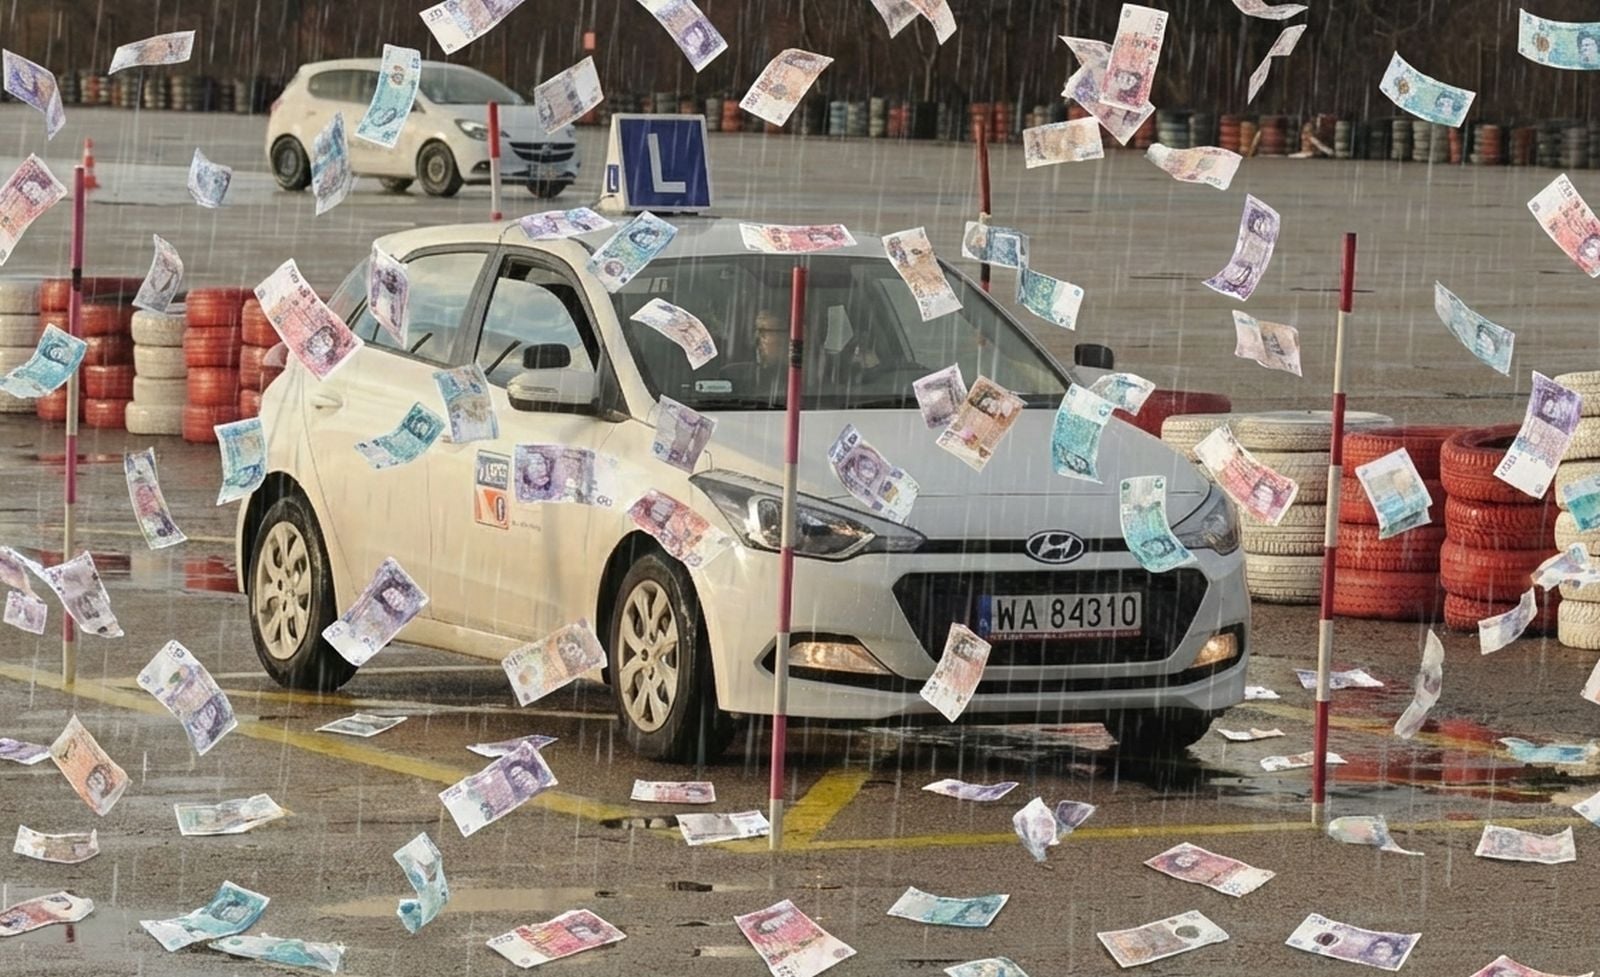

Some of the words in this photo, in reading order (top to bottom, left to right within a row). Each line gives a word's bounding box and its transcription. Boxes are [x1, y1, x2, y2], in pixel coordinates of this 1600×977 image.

[610, 168, 617, 190] L
[647, 133, 686, 193] L
[997, 599, 1038, 630] WA
[1051, 595, 1136, 629] 84310
